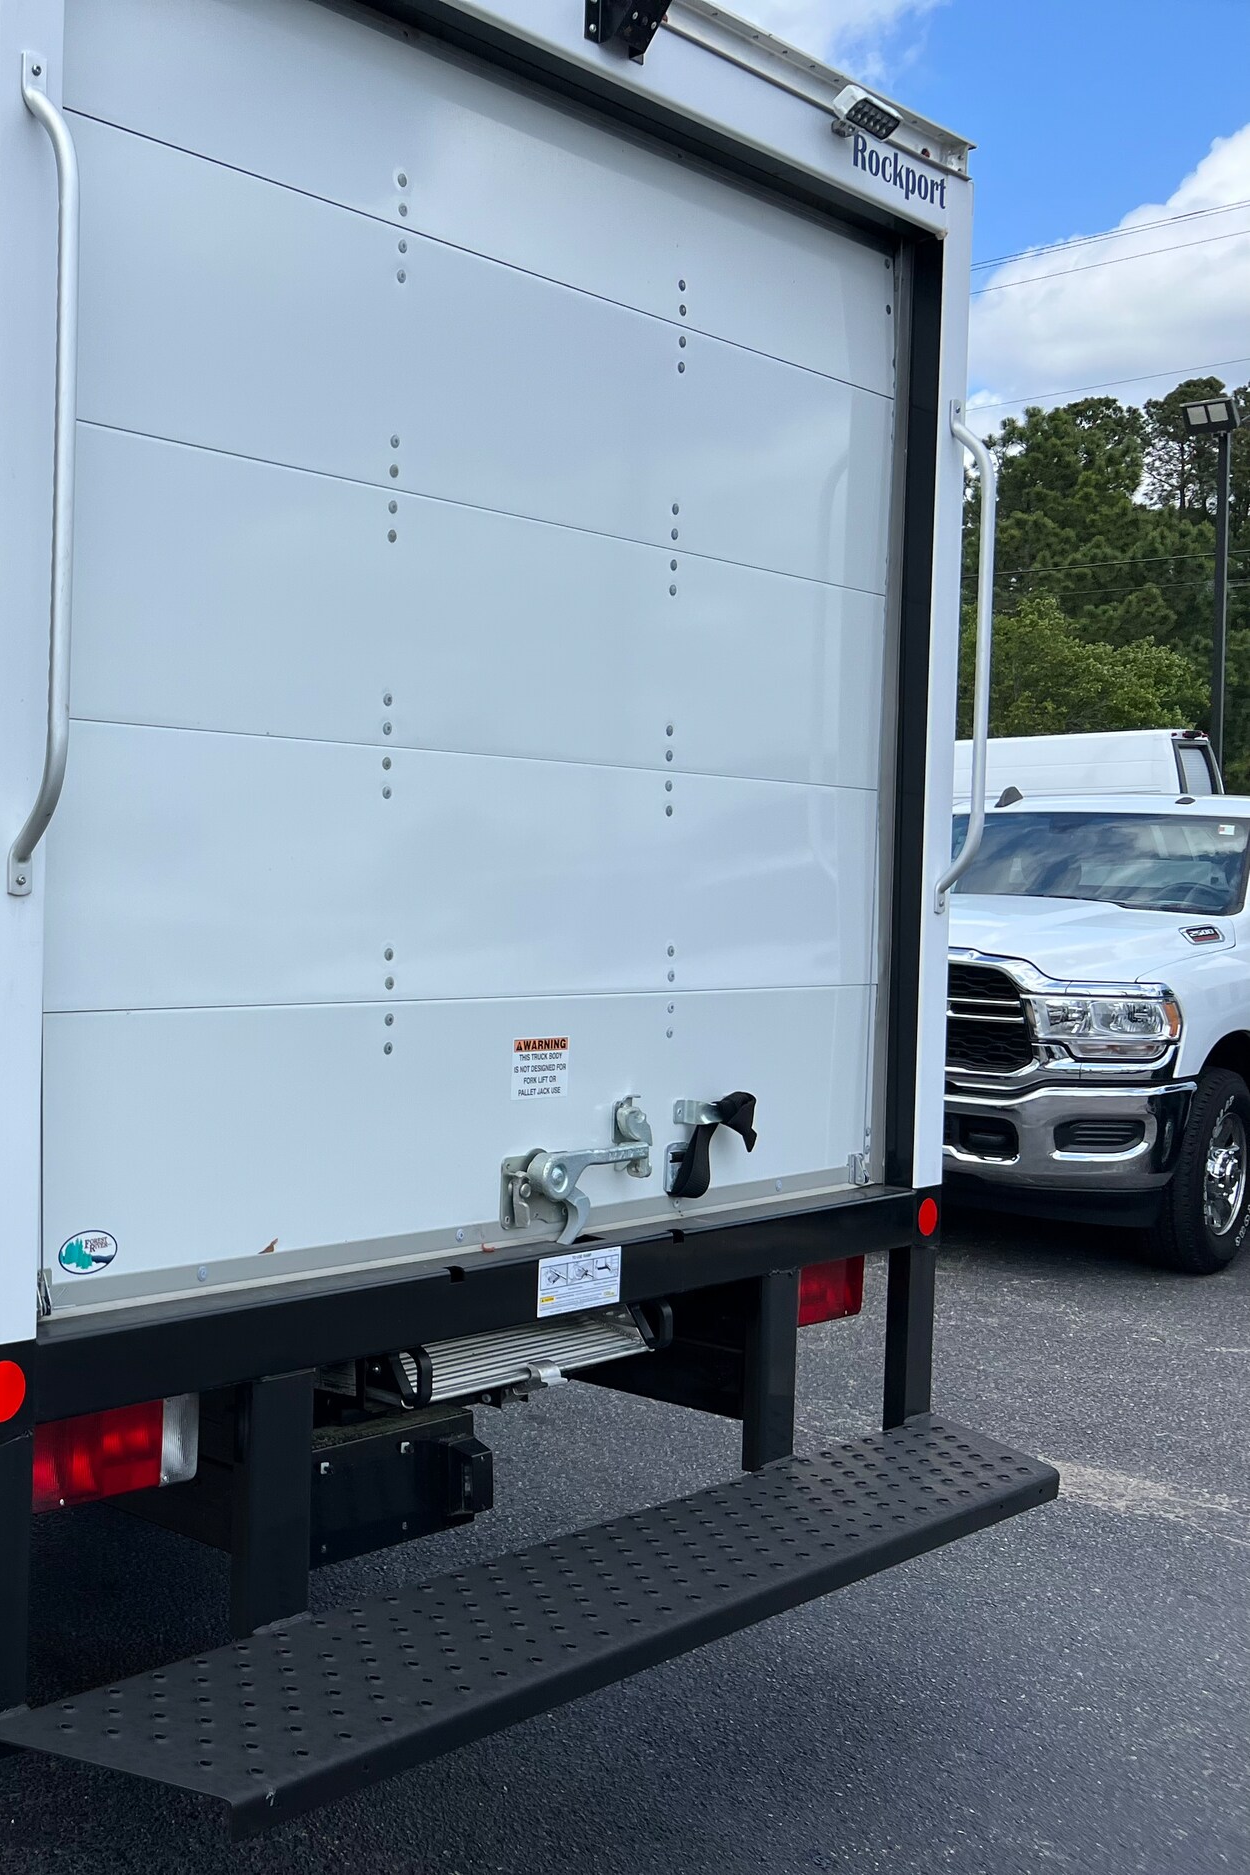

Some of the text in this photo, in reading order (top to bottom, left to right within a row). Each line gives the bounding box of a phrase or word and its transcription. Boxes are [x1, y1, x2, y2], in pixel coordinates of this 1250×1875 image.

[853, 133, 946, 209] Rockport
[523, 1038, 566, 1051] WARNING
[549, 1052, 562, 1060] BODY
[520, 1065, 530, 1073] NOT
[531, 1064, 555, 1072] DESIGNED
[556, 1063, 566, 1071] FOR
[518, 1086, 561, 1096] PALLET JACK USE
